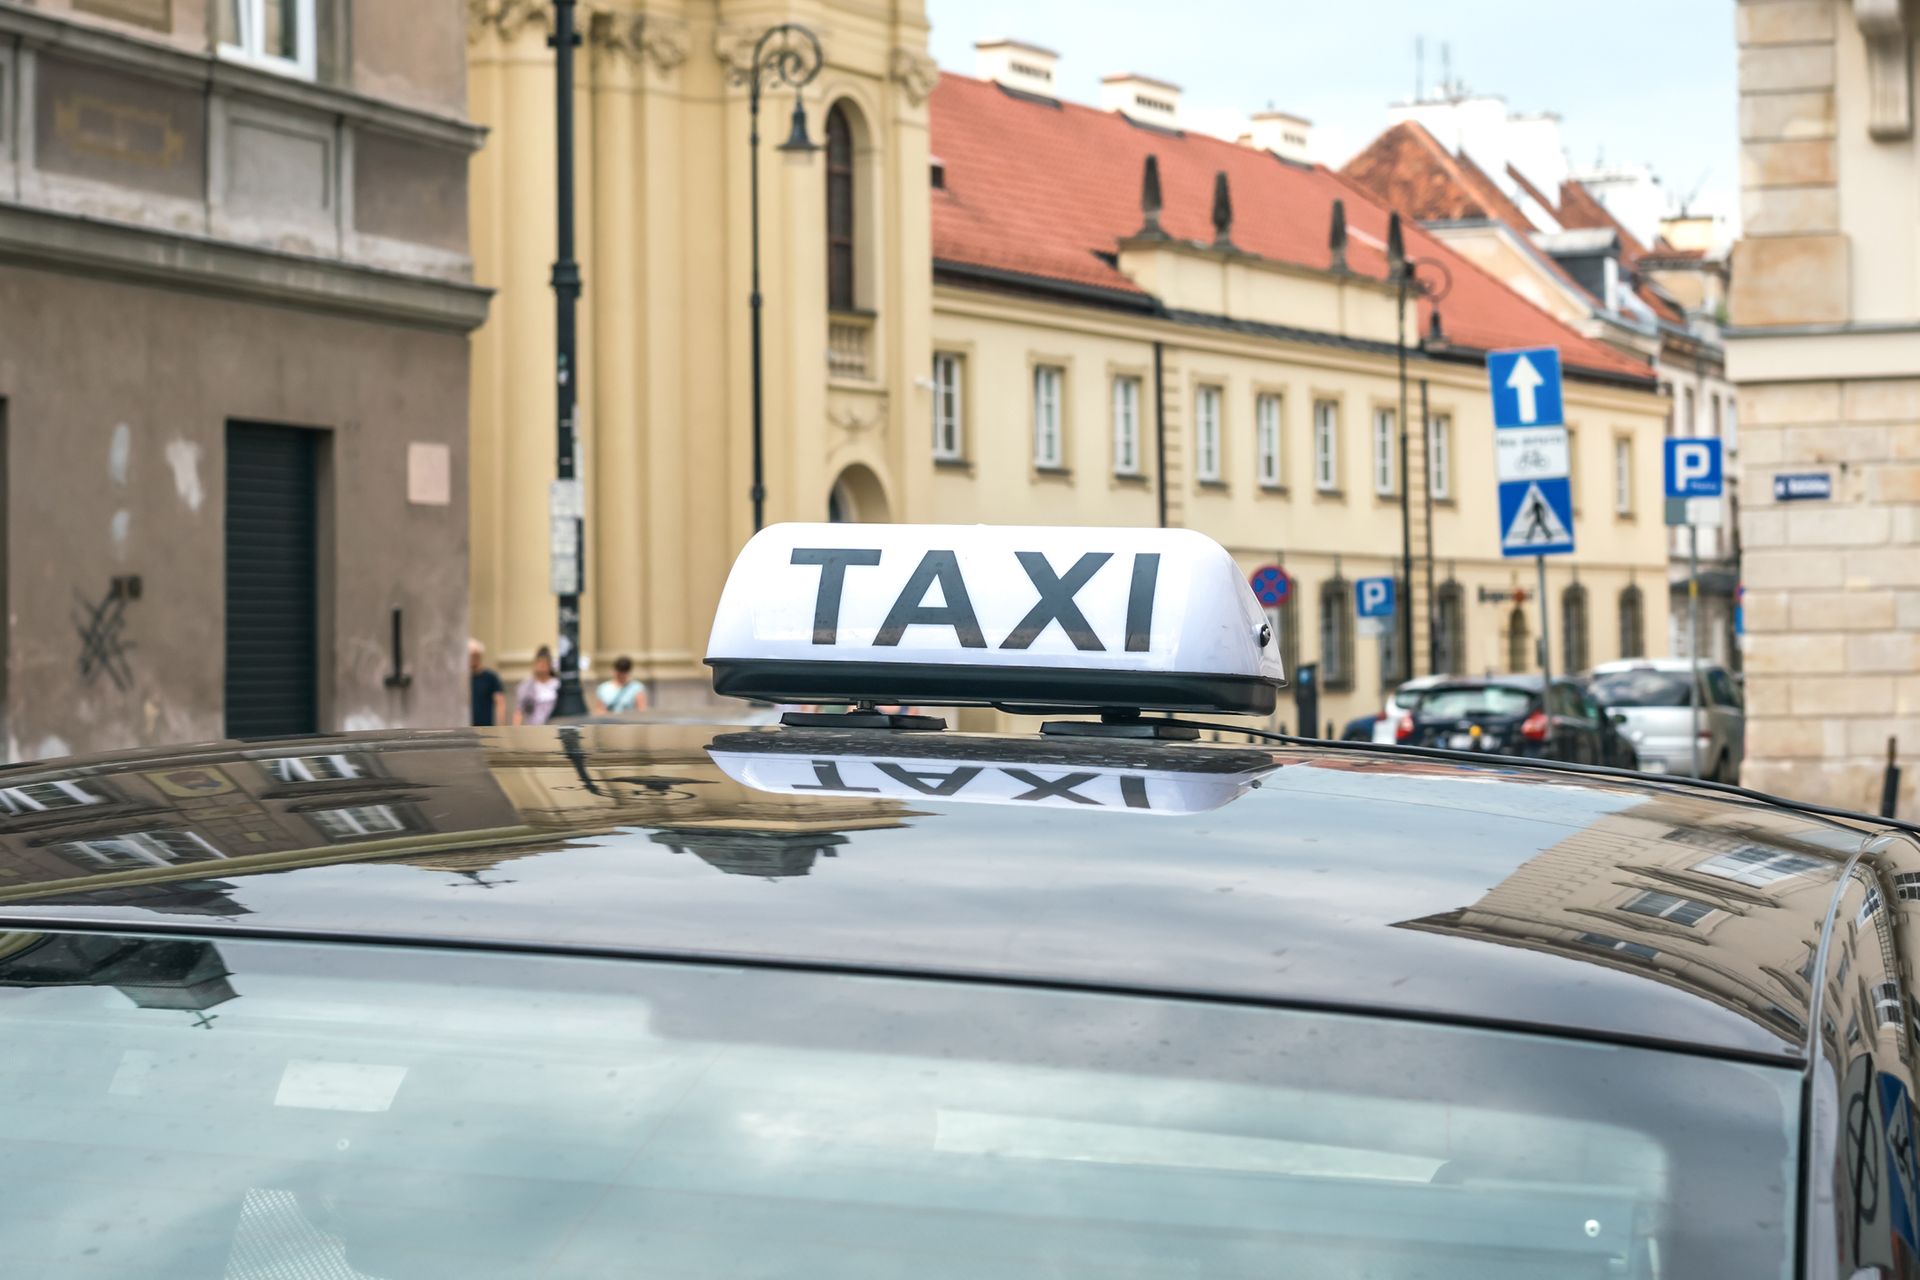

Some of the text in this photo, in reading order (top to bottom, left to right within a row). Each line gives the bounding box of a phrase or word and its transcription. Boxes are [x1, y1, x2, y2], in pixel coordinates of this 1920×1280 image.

[1676, 444, 1710, 491] P
[790, 548, 1161, 652] TAXI
[1363, 583, 1386, 611] P
